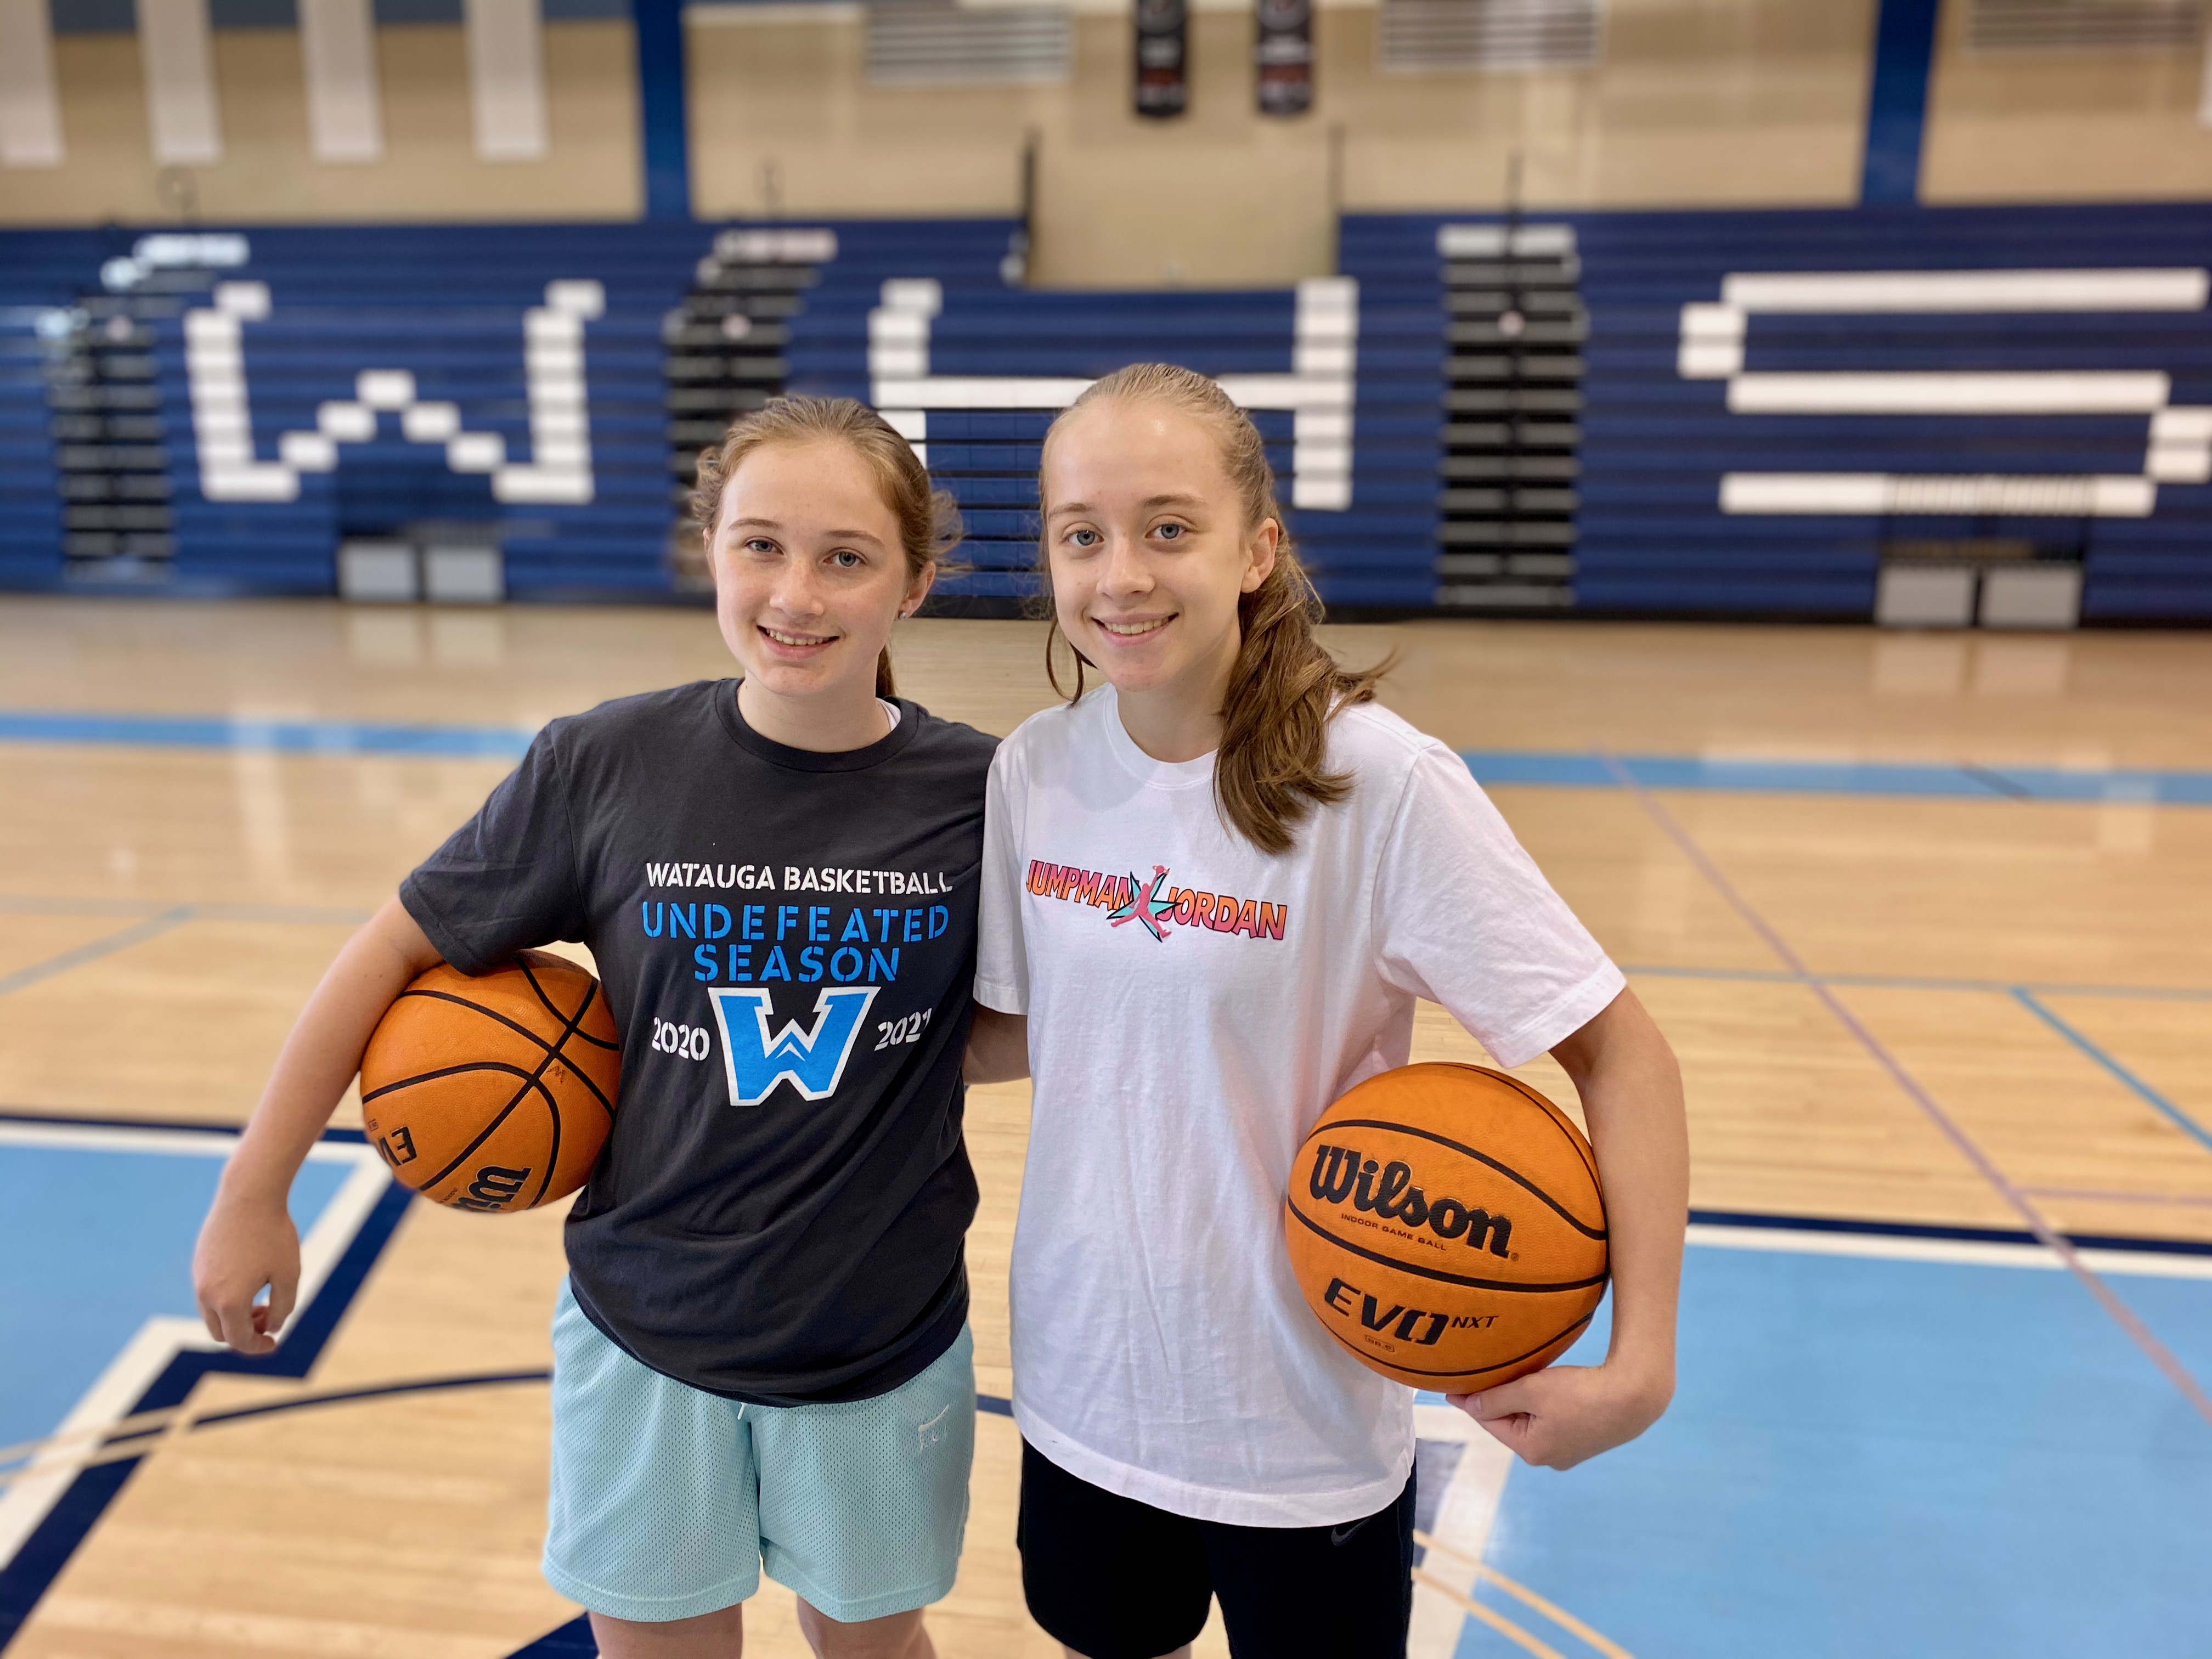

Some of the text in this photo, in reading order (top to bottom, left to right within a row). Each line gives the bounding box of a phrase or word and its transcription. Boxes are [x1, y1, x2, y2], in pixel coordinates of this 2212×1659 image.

[646, 862, 953, 895] WATAUGA BASKETBALL
[1026, 859, 1288, 940] JUMPMAN JORDAN
[642, 901, 949, 943] UNDEFEATED
[693, 944, 900, 982] SEASON
[652, 986, 932, 1107] 2020 W 2021
[1310, 1144, 1512, 1259] Wilson
[1341, 1213, 1447, 1251] INDOOR GAME BALL
[1324, 1277, 1499, 1346] EVO NXT
